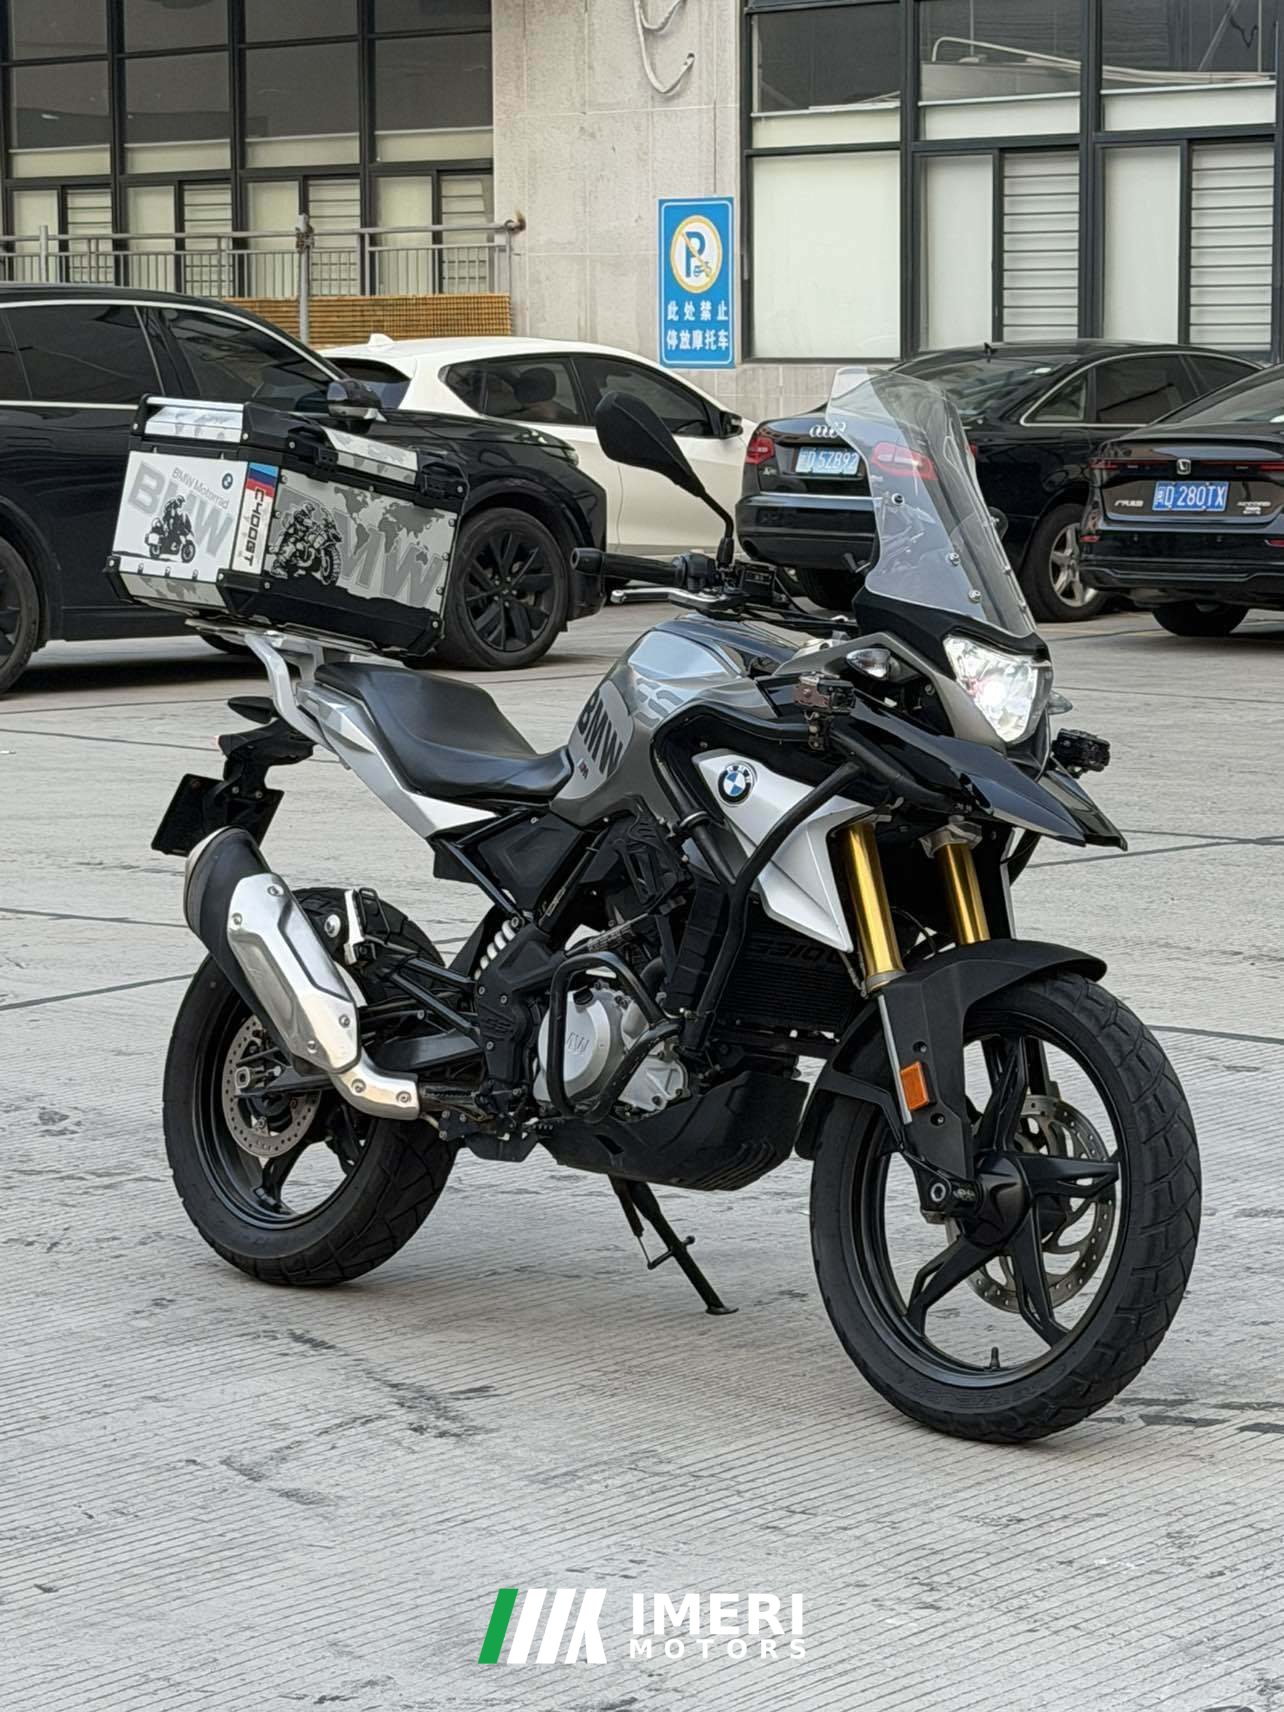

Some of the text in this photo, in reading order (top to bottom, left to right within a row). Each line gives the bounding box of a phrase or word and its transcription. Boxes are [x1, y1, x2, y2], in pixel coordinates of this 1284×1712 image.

[666, 300, 729, 321] 此处禁止
[666, 329, 729, 351] 停放摩托车
[244, 487, 264, 567] C400GT
[578, 687, 624, 779] BMW
